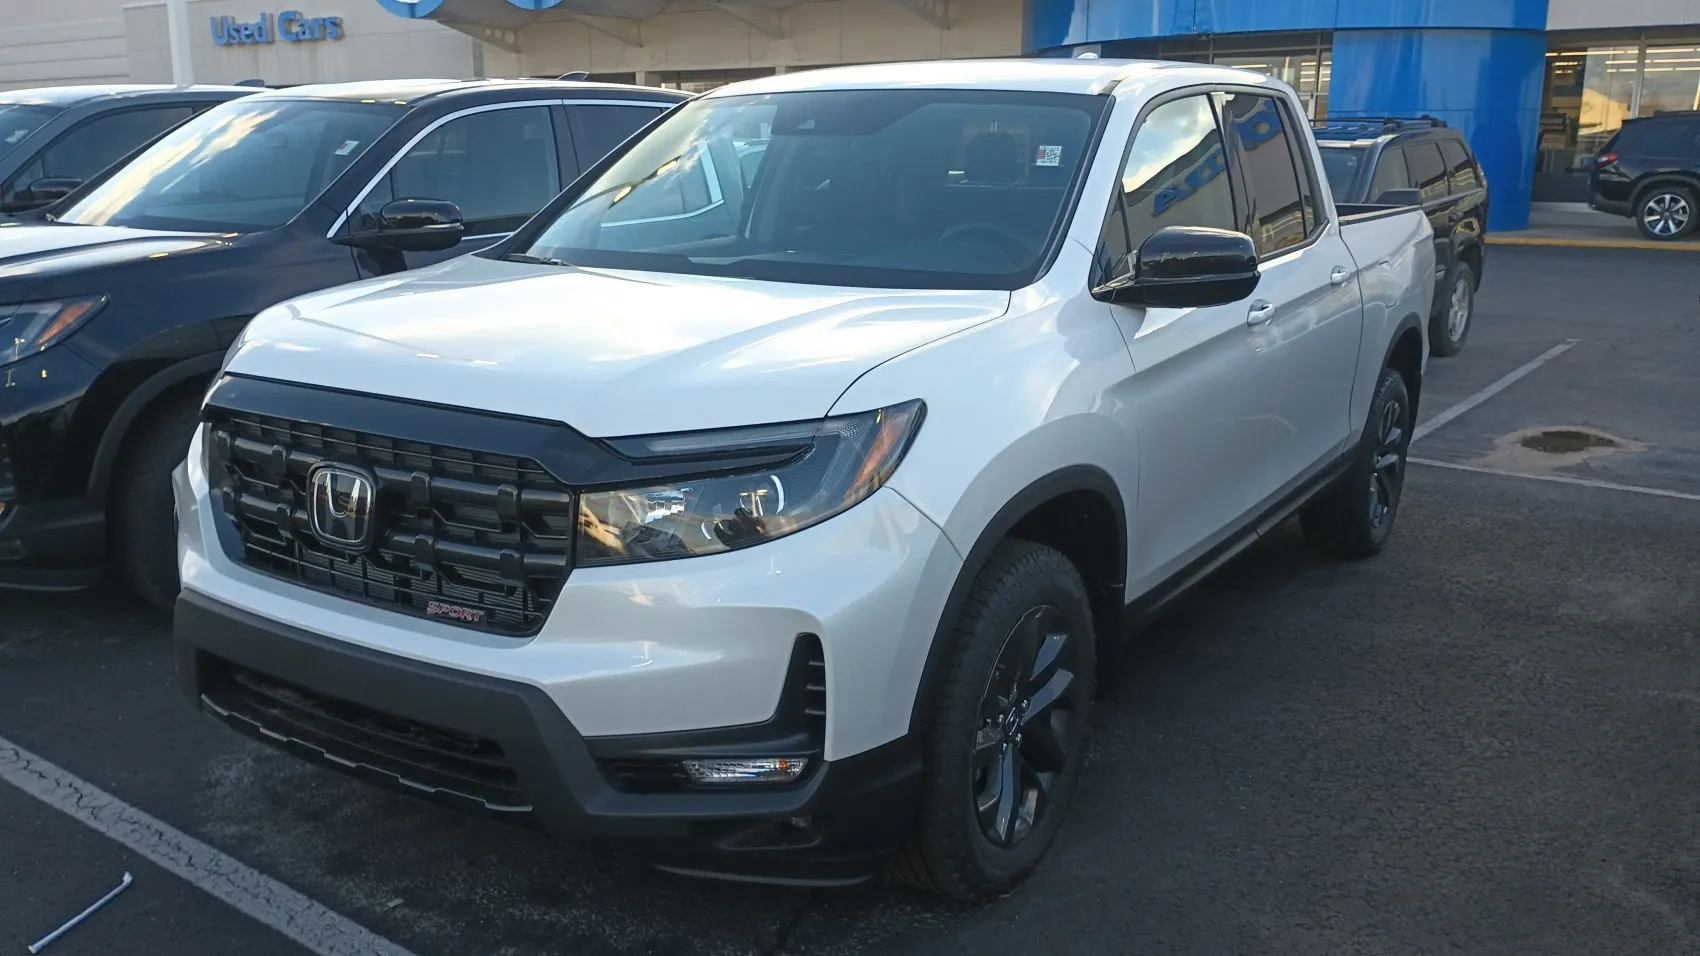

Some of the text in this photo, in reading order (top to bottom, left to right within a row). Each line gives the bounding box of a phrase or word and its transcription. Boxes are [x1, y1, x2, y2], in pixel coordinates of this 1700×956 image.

[210, 10, 344, 45] Used Cars
[427, 600, 485, 622] SPORT
